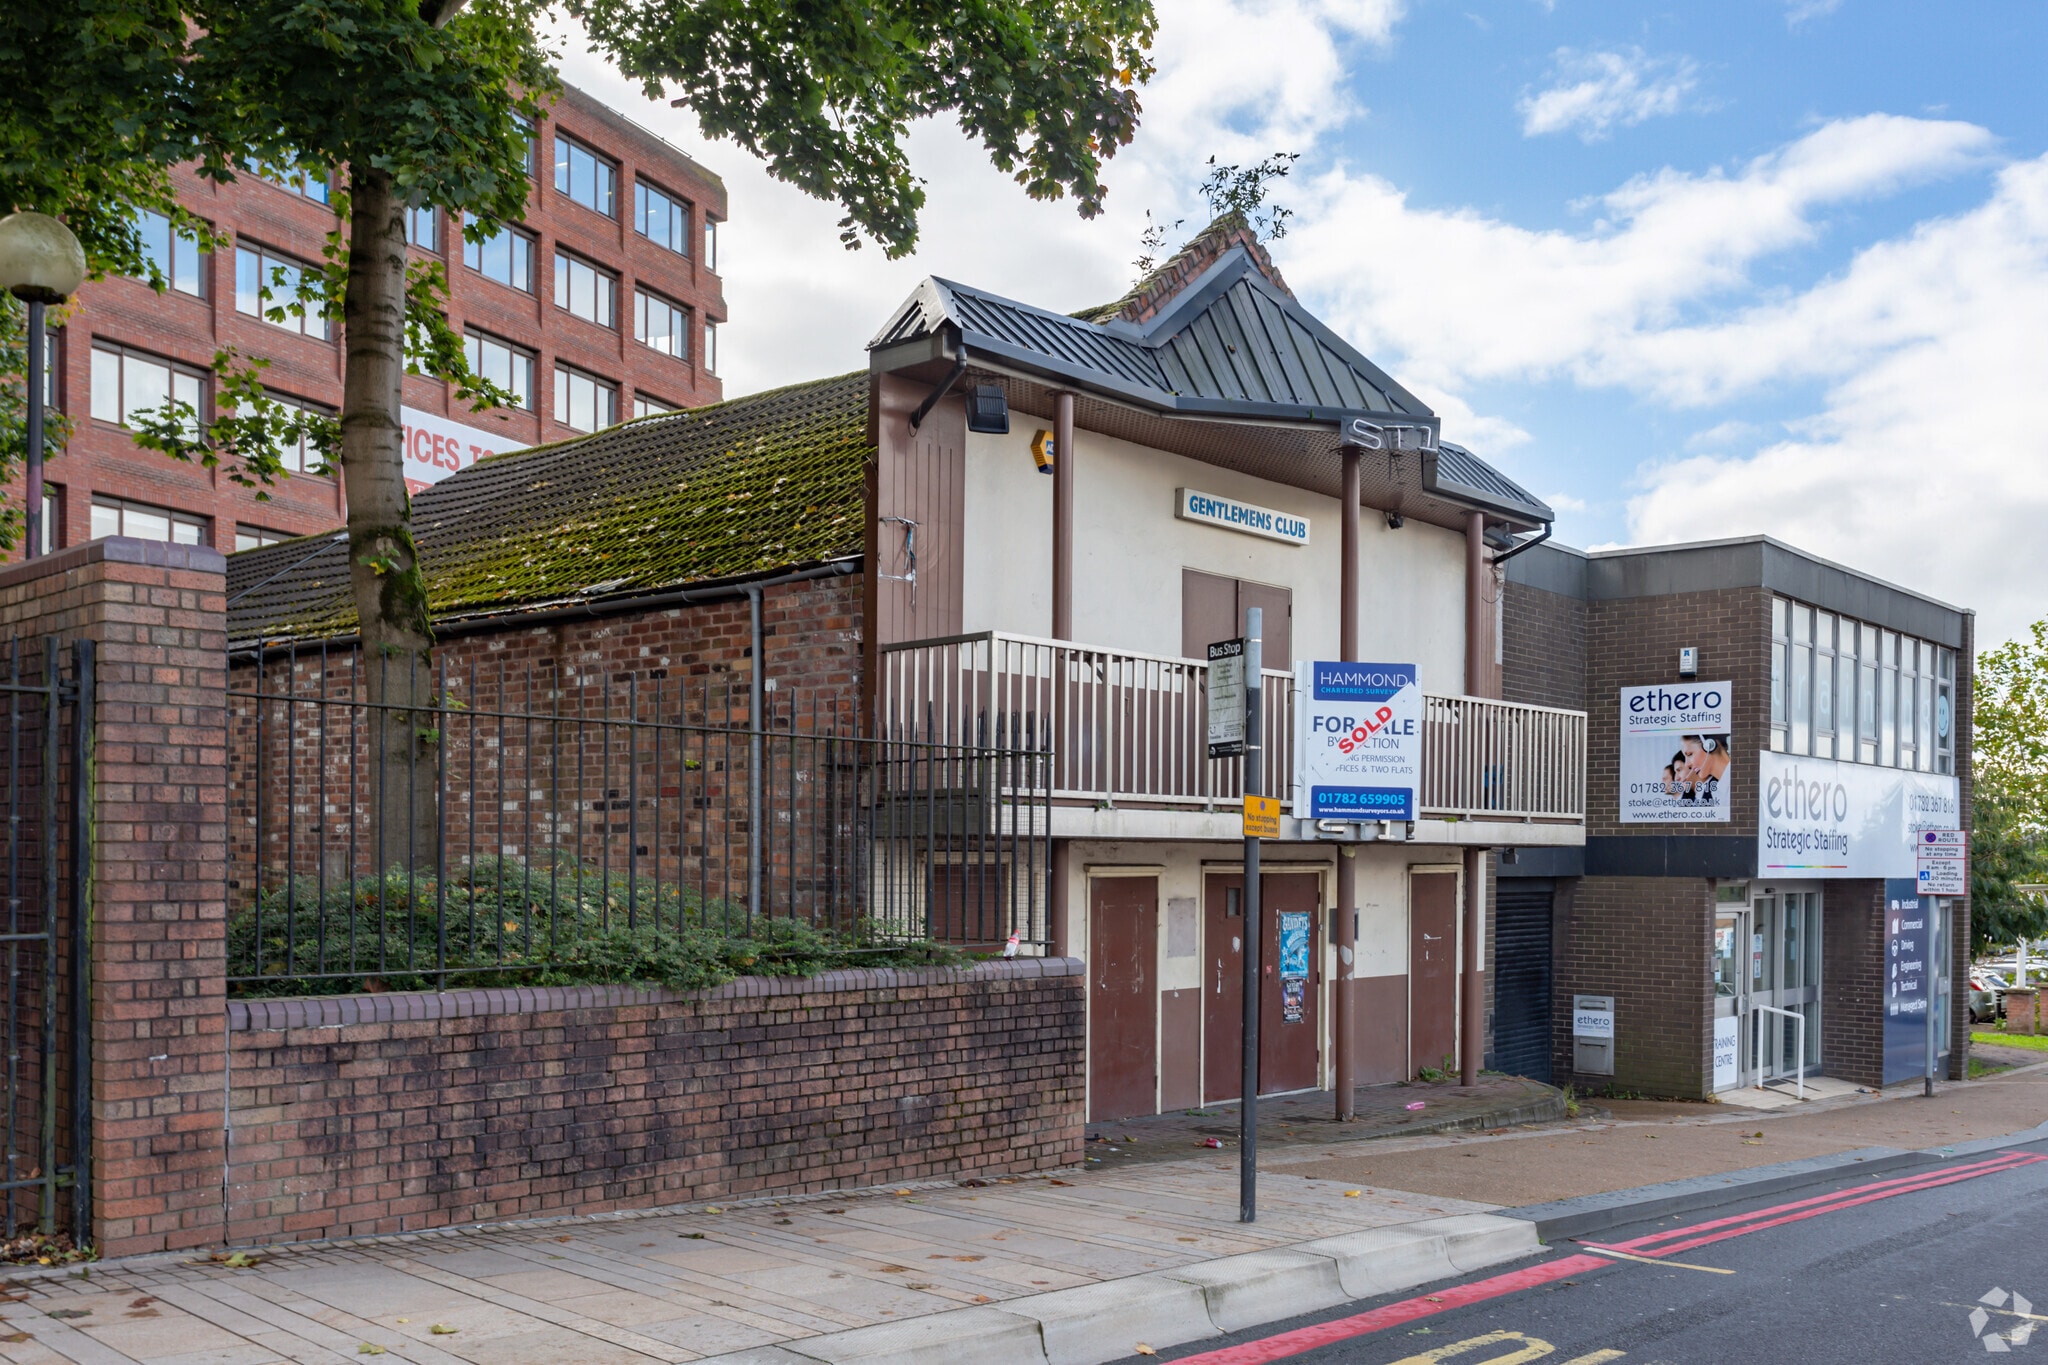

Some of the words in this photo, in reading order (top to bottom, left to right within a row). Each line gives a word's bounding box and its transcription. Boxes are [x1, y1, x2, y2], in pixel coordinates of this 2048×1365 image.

[400, 424, 460, 472] ICES
[1189, 495, 1272, 531] GENTLEMENS
[1275, 516, 1306, 539] CLUB
[1209, 645, 1223, 658] Bus
[1224, 643, 1241, 655] Stop
[1320, 671, 1408, 687] HAMMOND
[1320, 686, 1364, 694] CHARTERED
[1629, 688, 1722, 713] ethero
[1313, 716, 1355, 733] FOR
[1629, 714, 1677, 726] Strategic
[1680, 711, 1722, 724] Staffing
[1338, 706, 1393, 754] SOLD
[1363, 738, 1400, 749] TION
[1361, 754, 1406, 763] PERMISSION
[1371, 766, 1389, 774] TWO
[1391, 766, 1413, 774] FLATS
[1630, 782, 1666, 793] 01782
[1670, 782, 1692, 793] 367
[1695, 781, 1718, 792] 818
[1767, 764, 1847, 823] ethero
[1318, 792, 1357, 804] 01782
[1360, 793, 1406, 805] 659905
[1318, 807, 1405, 815] www.hammondsurveyors.co.uk
[1632, 810, 1716, 819] www.ethero.co.uk
[1247, 813, 1255, 821] No
[1256, 814, 1277, 825] stopping
[1246, 825, 1263, 833] except
[1766, 826, 1811, 855] Strategic
[1813, 829, 1848, 856] Staffing
[1901, 918, 1923, 930] Commercial
[1900, 939, 1915, 952] Driving
[1900, 960, 1922, 973] Engineering
[1900, 979, 1918, 992] Technical
[1900, 999, 1918, 1013] Managed
[1577, 1015, 1610, 1026] ethero
[1715, 1053, 1733, 1067] CENTRE
